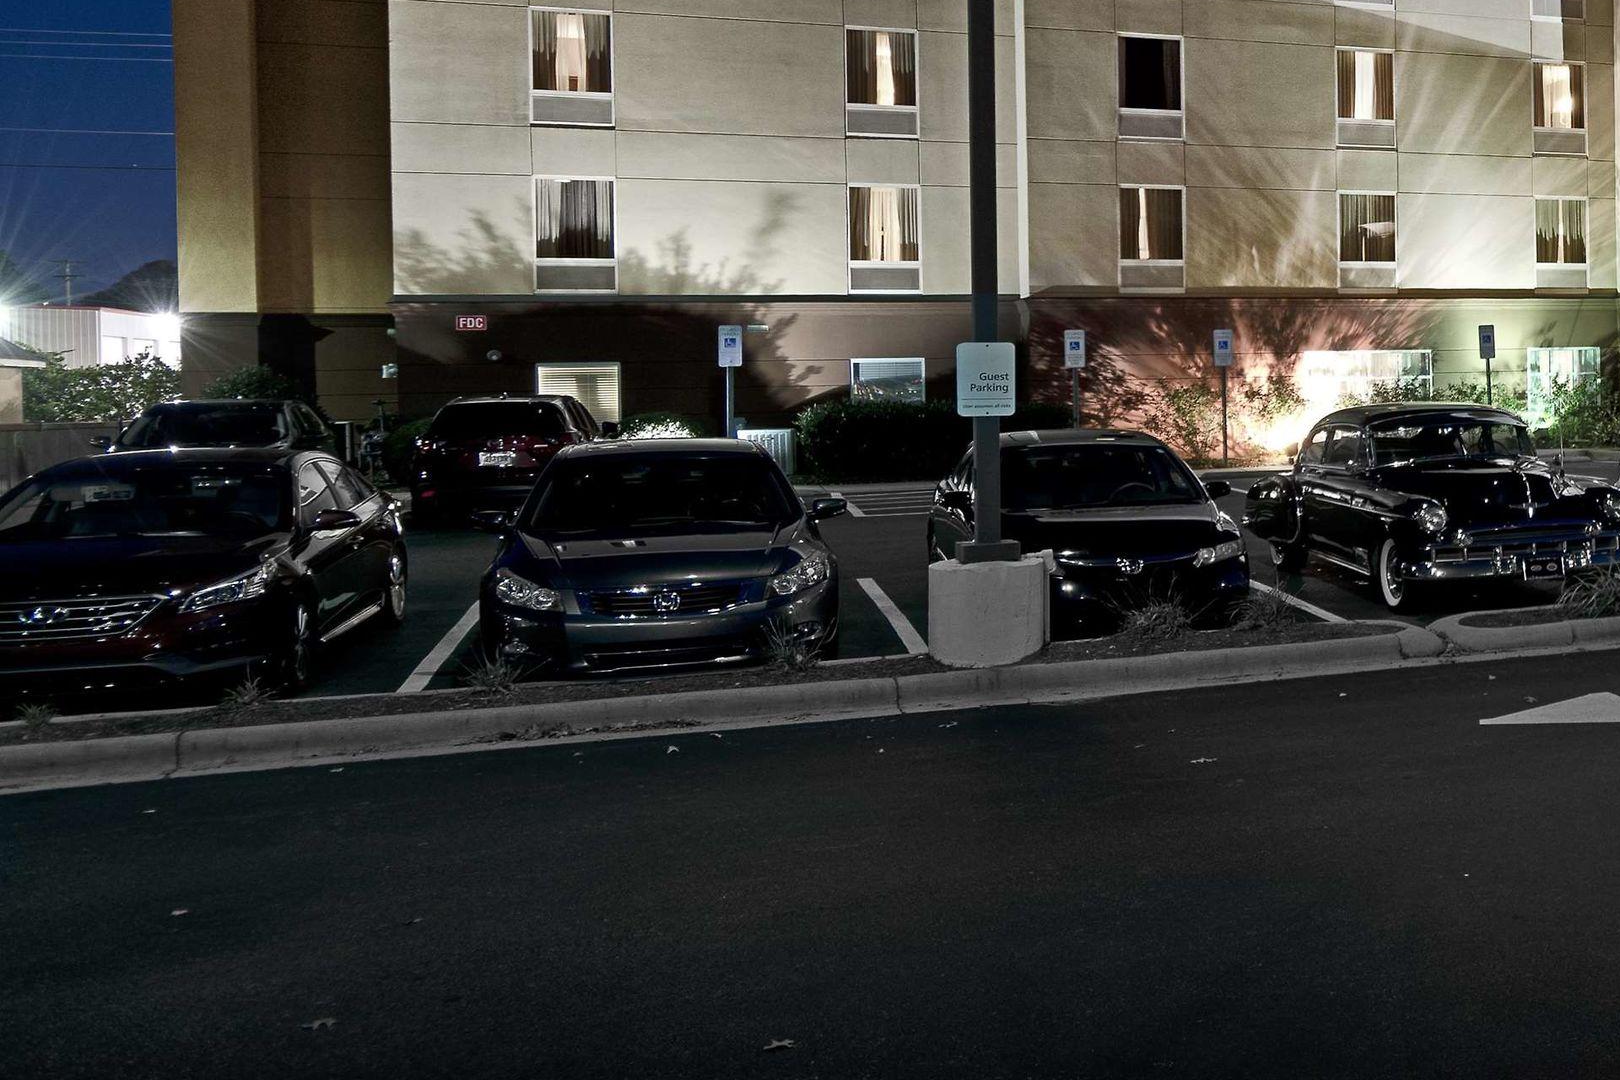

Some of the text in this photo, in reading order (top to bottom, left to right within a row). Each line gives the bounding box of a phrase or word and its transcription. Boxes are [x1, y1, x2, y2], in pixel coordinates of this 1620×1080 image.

[459, 317, 484, 328] FDC
[979, 372, 1010, 381] Guest
[970, 383, 1009, 393] Parking
